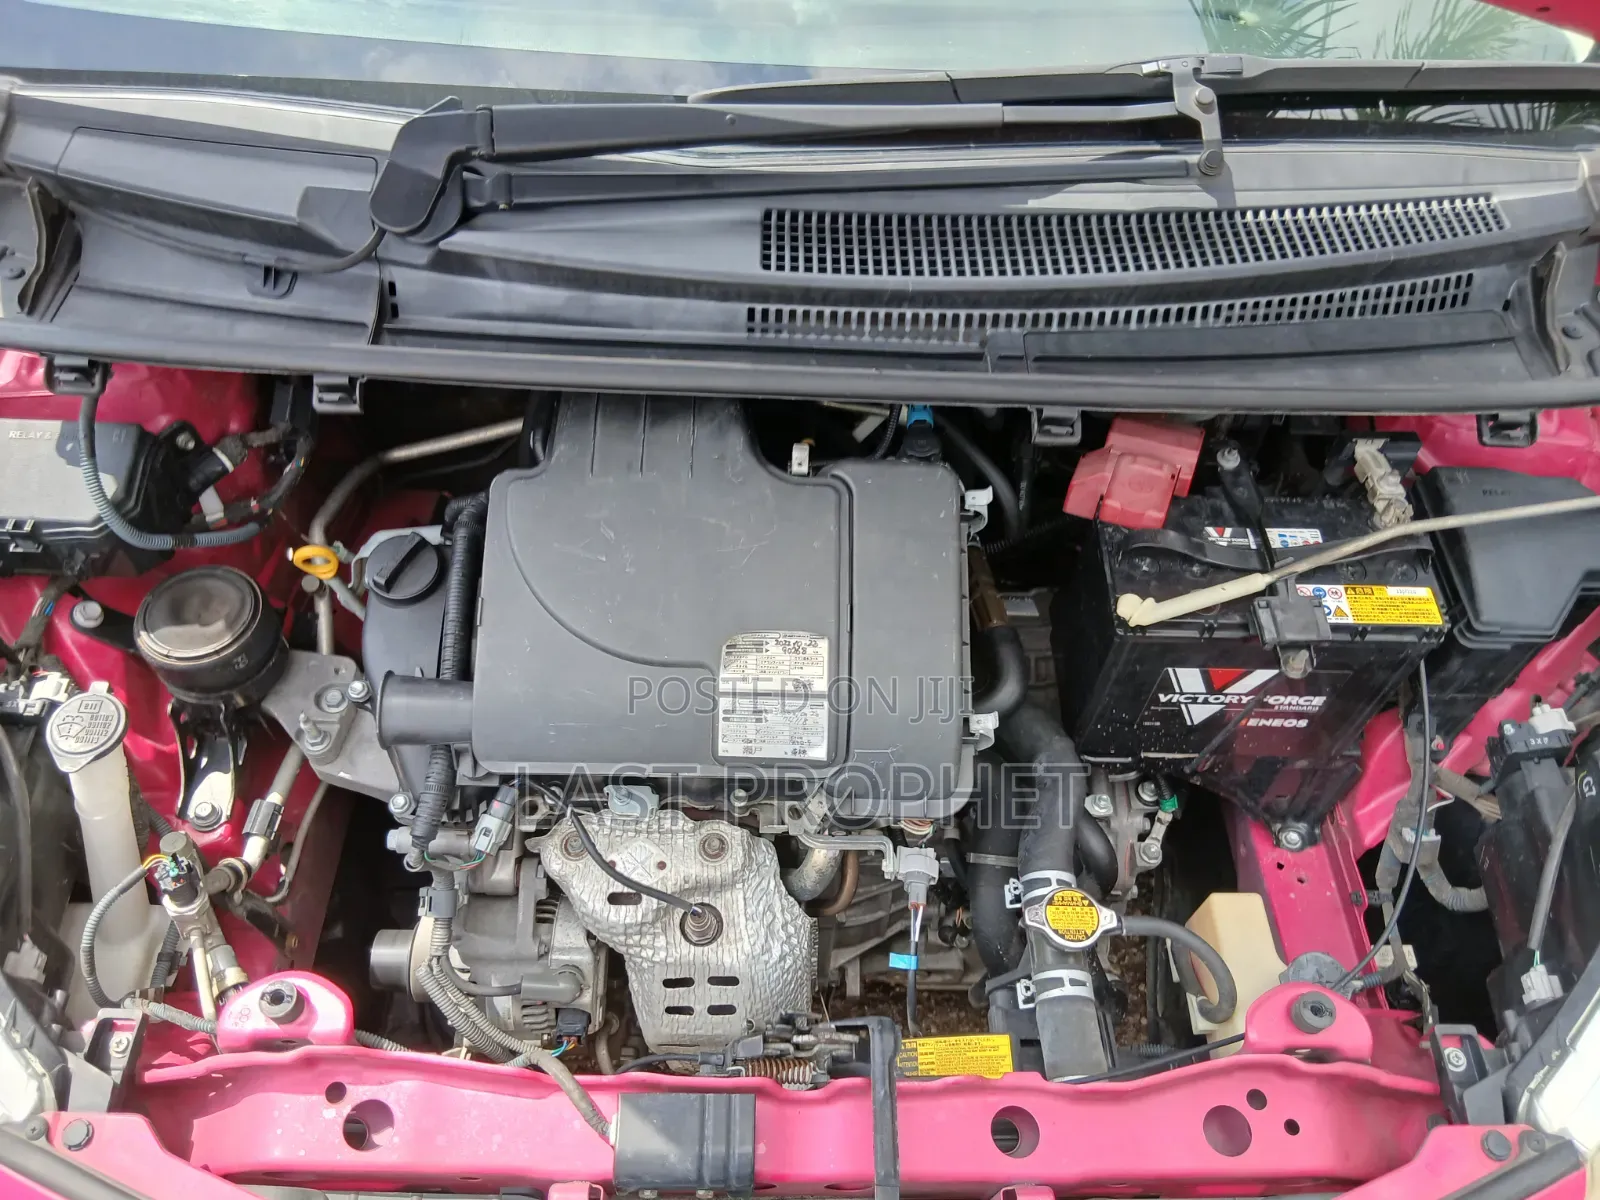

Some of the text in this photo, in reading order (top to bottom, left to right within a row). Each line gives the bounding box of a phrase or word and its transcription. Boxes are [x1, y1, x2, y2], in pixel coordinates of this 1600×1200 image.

[8, 430, 42, 439] RELAY
[1158, 693, 1256, 704] VICTORY
[1246, 718, 1308, 728] ENEOS
